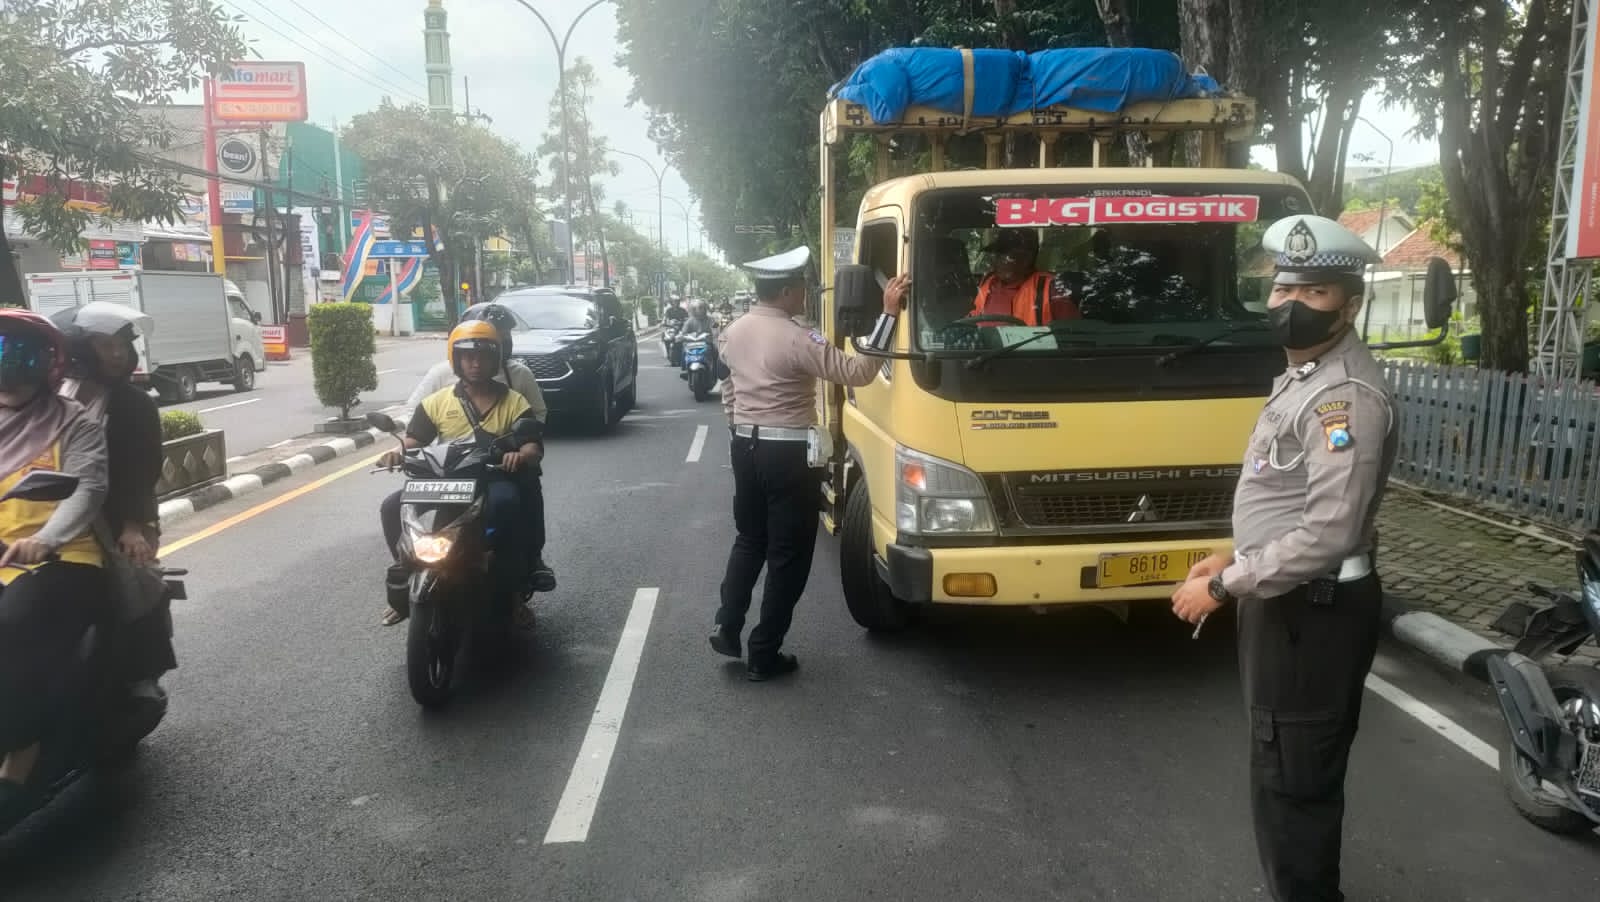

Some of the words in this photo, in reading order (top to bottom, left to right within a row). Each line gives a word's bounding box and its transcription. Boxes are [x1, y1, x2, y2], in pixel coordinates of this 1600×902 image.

[1105, 201, 1248, 218] LOGISTIK
[1030, 469, 1181, 483] MITSUBISHI
[1103, 560, 1113, 578] L
[1129, 554, 1169, 574] 8618
